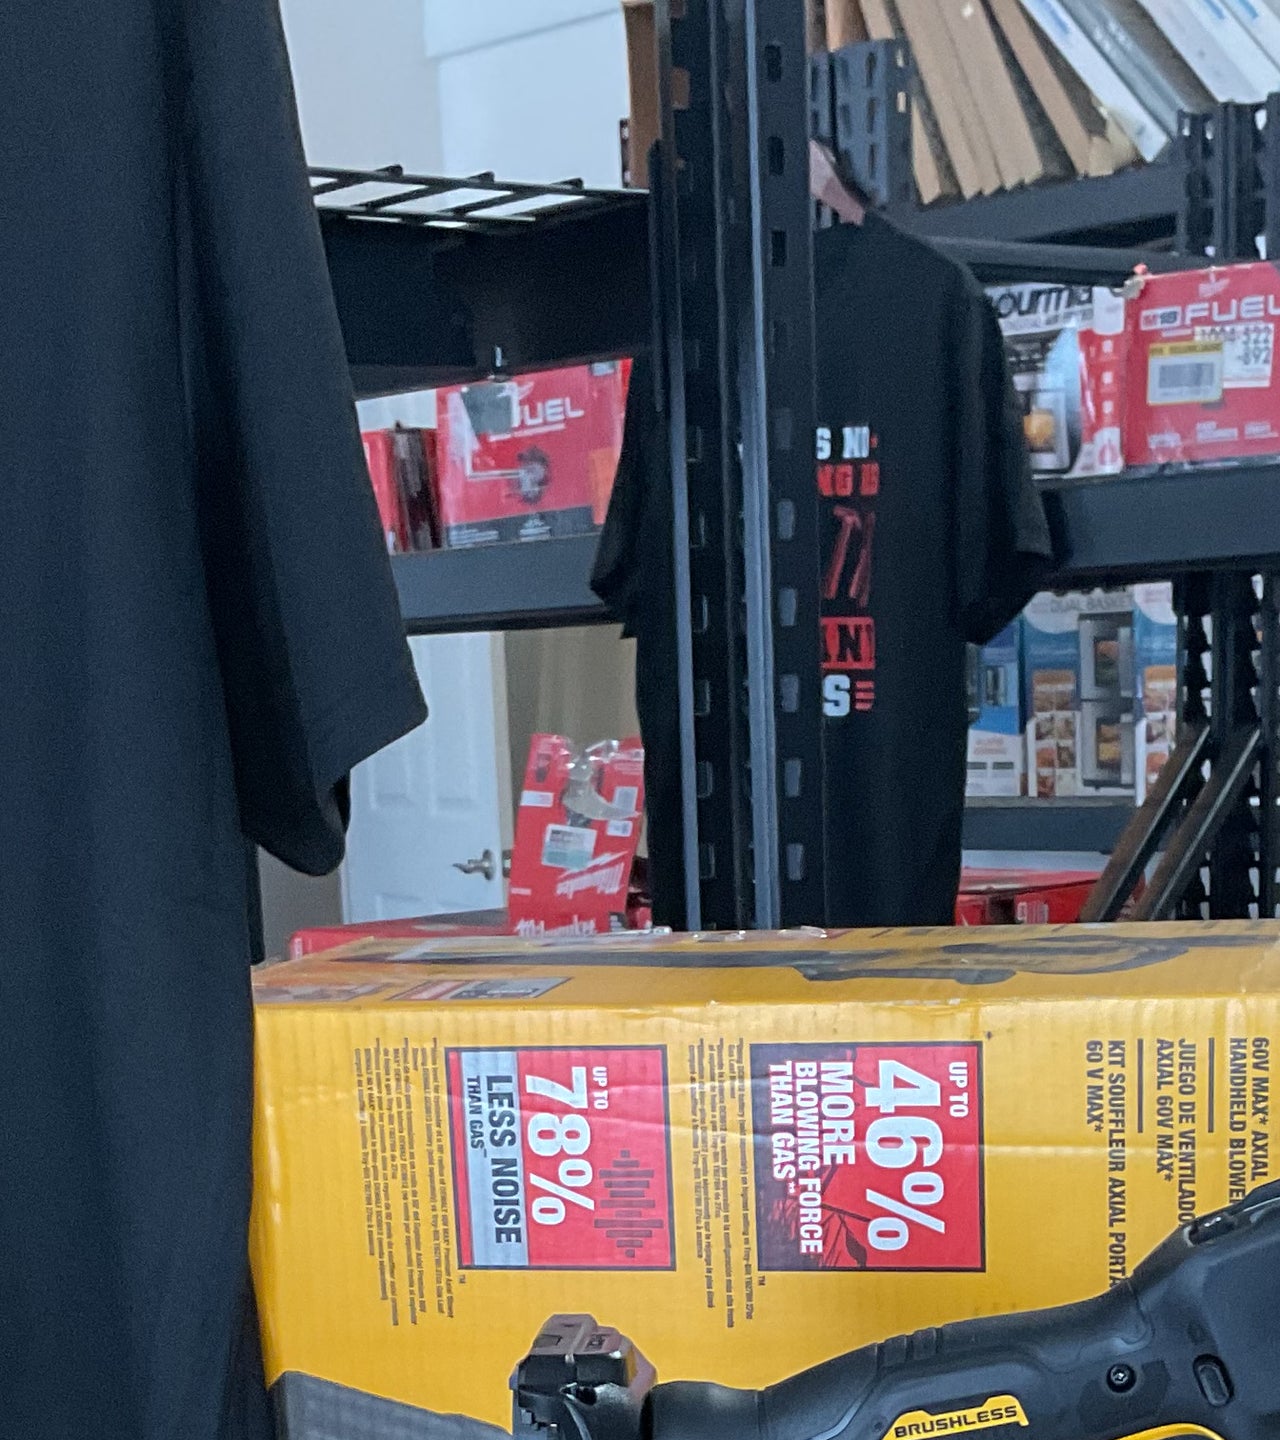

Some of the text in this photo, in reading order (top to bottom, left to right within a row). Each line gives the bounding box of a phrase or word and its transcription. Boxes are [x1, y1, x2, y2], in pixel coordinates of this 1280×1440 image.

[521, 397, 585, 427] UEL
[816, 427, 832, 460] S
[1085, 1040, 1103, 1064] 60
[1086, 1067, 1103, 1081] V
[1155, 1038, 1174, 1091] AXIAL
[1250, 1037, 1269, 1072] 60V
[466, 1075, 482, 1116] THAN
[592, 1066, 609, 1111] UP TO
[769, 1060, 793, 1126] THAN
[819, 1060, 856, 1167] MORE
[948, 1061, 970, 1118] UP TO
[1155, 1095, 1174, 1129] 60V
[525, 1065, 596, 1227] 78%
[1176, 1038, 1196, 1225] JUEGO DE VENTILADO
[1227, 1037, 1247, 1205] HANDHELD BLOWE
[486, 1074, 523, 1245] LESS NOISE
[793, 1060, 824, 1255] BLOWING FORCE
[864, 1058, 947, 1252] 46%
[1106, 1039, 1126, 1289] KIT SOUFFLEUR AXIAL PORTA
[1250, 1129, 1269, 1182] AXIAL
[893, 1404, 1019, 1439] BRUSHLESS
